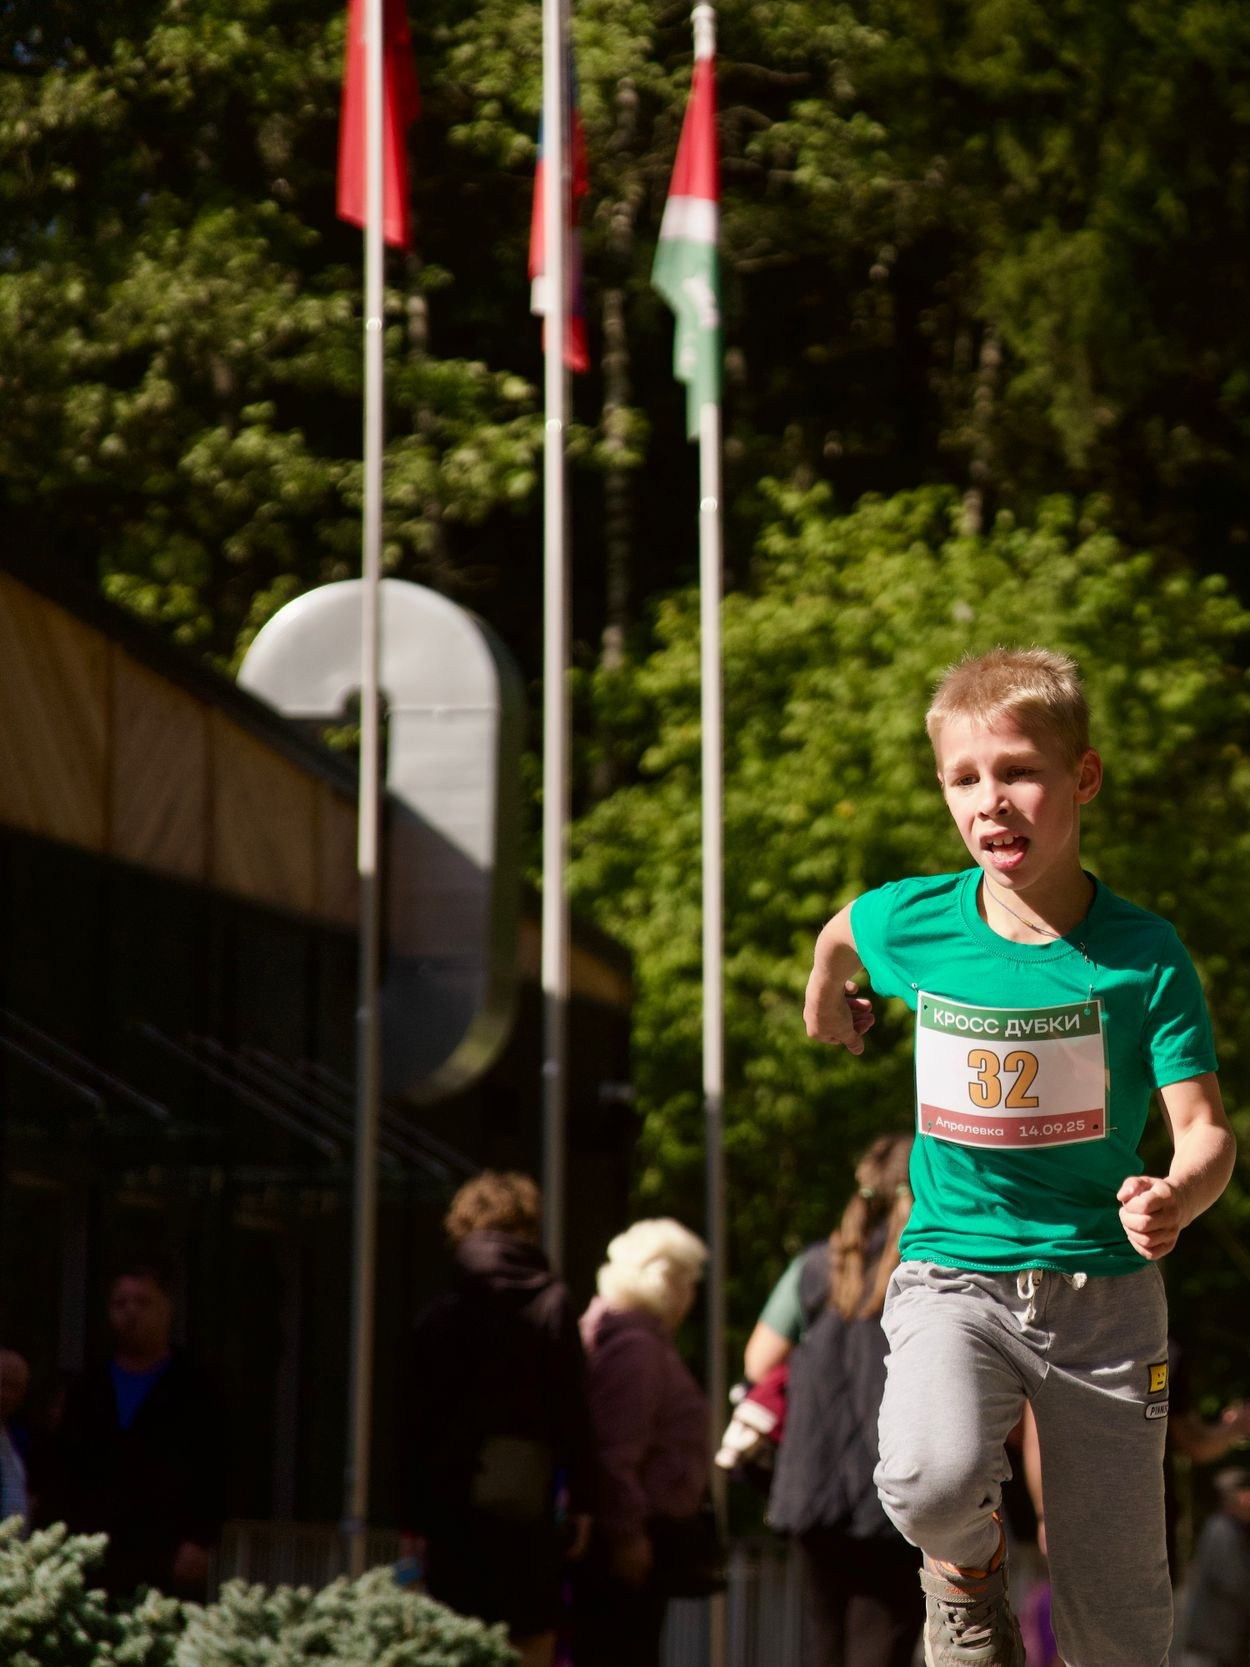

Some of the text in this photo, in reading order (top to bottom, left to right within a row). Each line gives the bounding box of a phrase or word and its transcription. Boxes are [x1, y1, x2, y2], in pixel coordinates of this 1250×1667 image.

[933, 1008, 1080, 1037] КРОСС ДУБКИ
[967, 1049, 1039, 1109] 32
[935, 1116, 1085, 1137] Апрелевка 14.09.25
